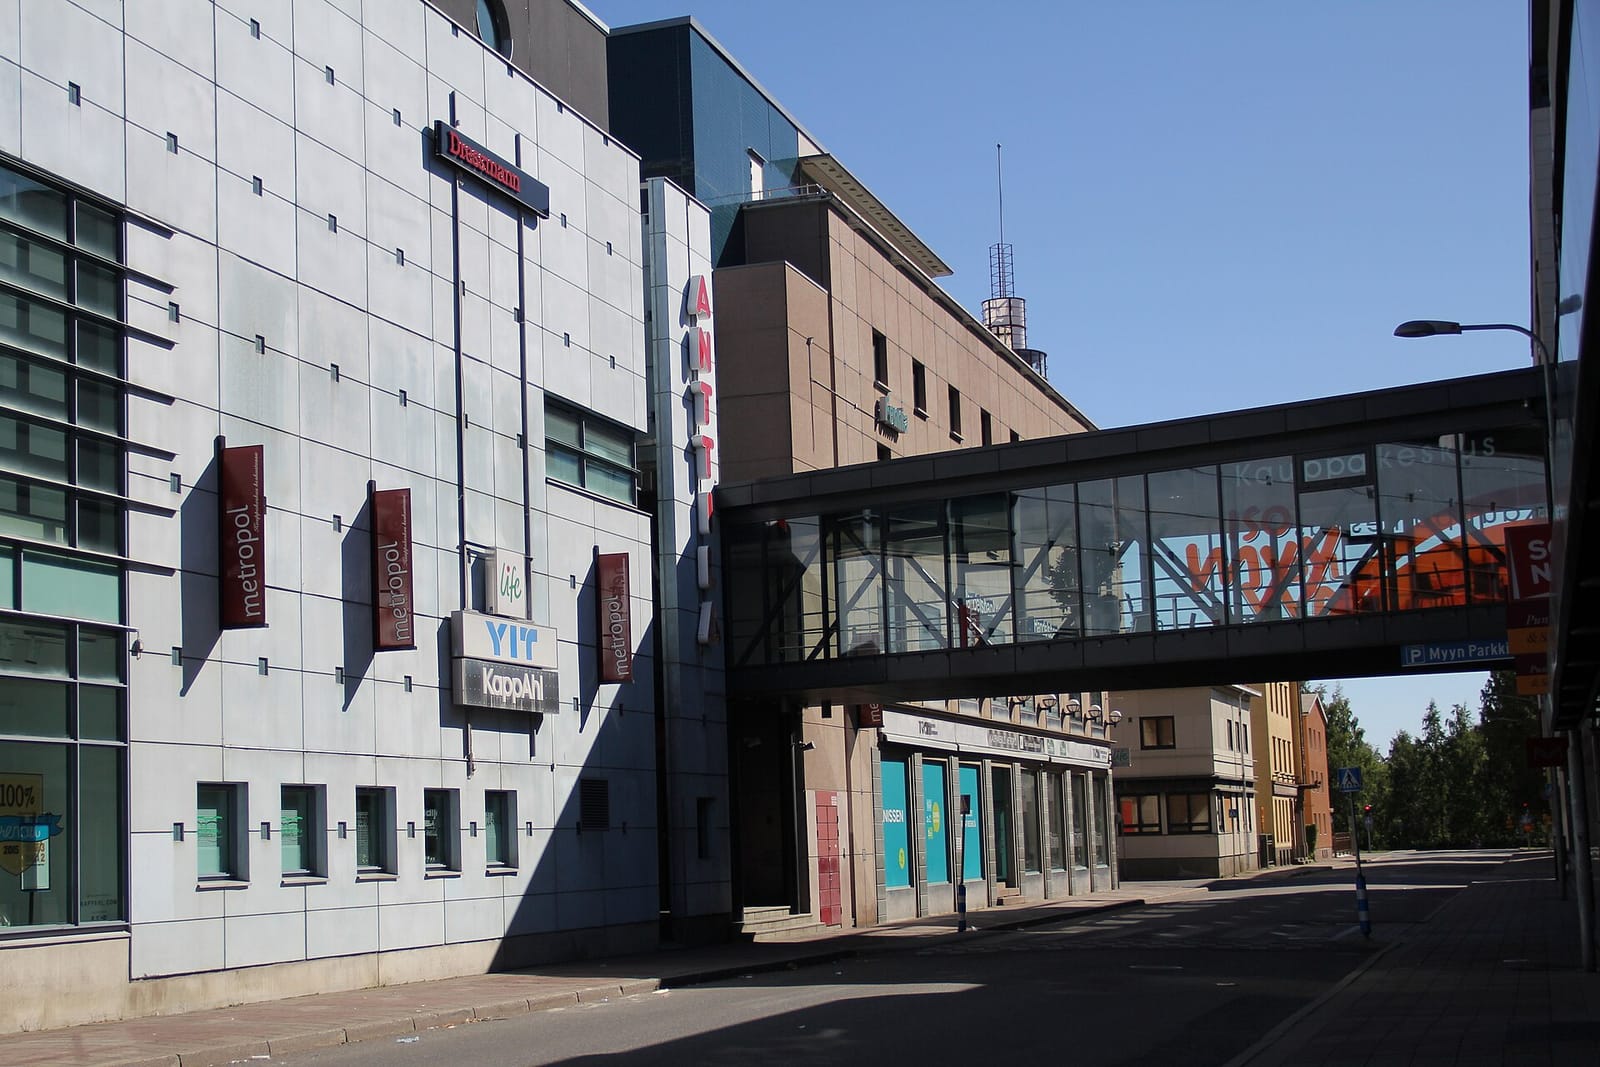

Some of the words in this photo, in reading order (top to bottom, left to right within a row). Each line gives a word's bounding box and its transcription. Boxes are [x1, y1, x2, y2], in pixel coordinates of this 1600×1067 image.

[448, 130, 521, 193] Dressmann
[226, 504, 262, 617] metropol
[1527, 539, 1552, 561] S
[379, 541, 411, 642] metropol
[500, 562, 522, 604] life
[484, 620, 538, 661] YIT
[606, 595, 631, 678] metropol
[1429, 646, 1465, 662] Myyn
[482, 667, 544, 703] KappAhl
[0, 783, 35, 808] 100%
